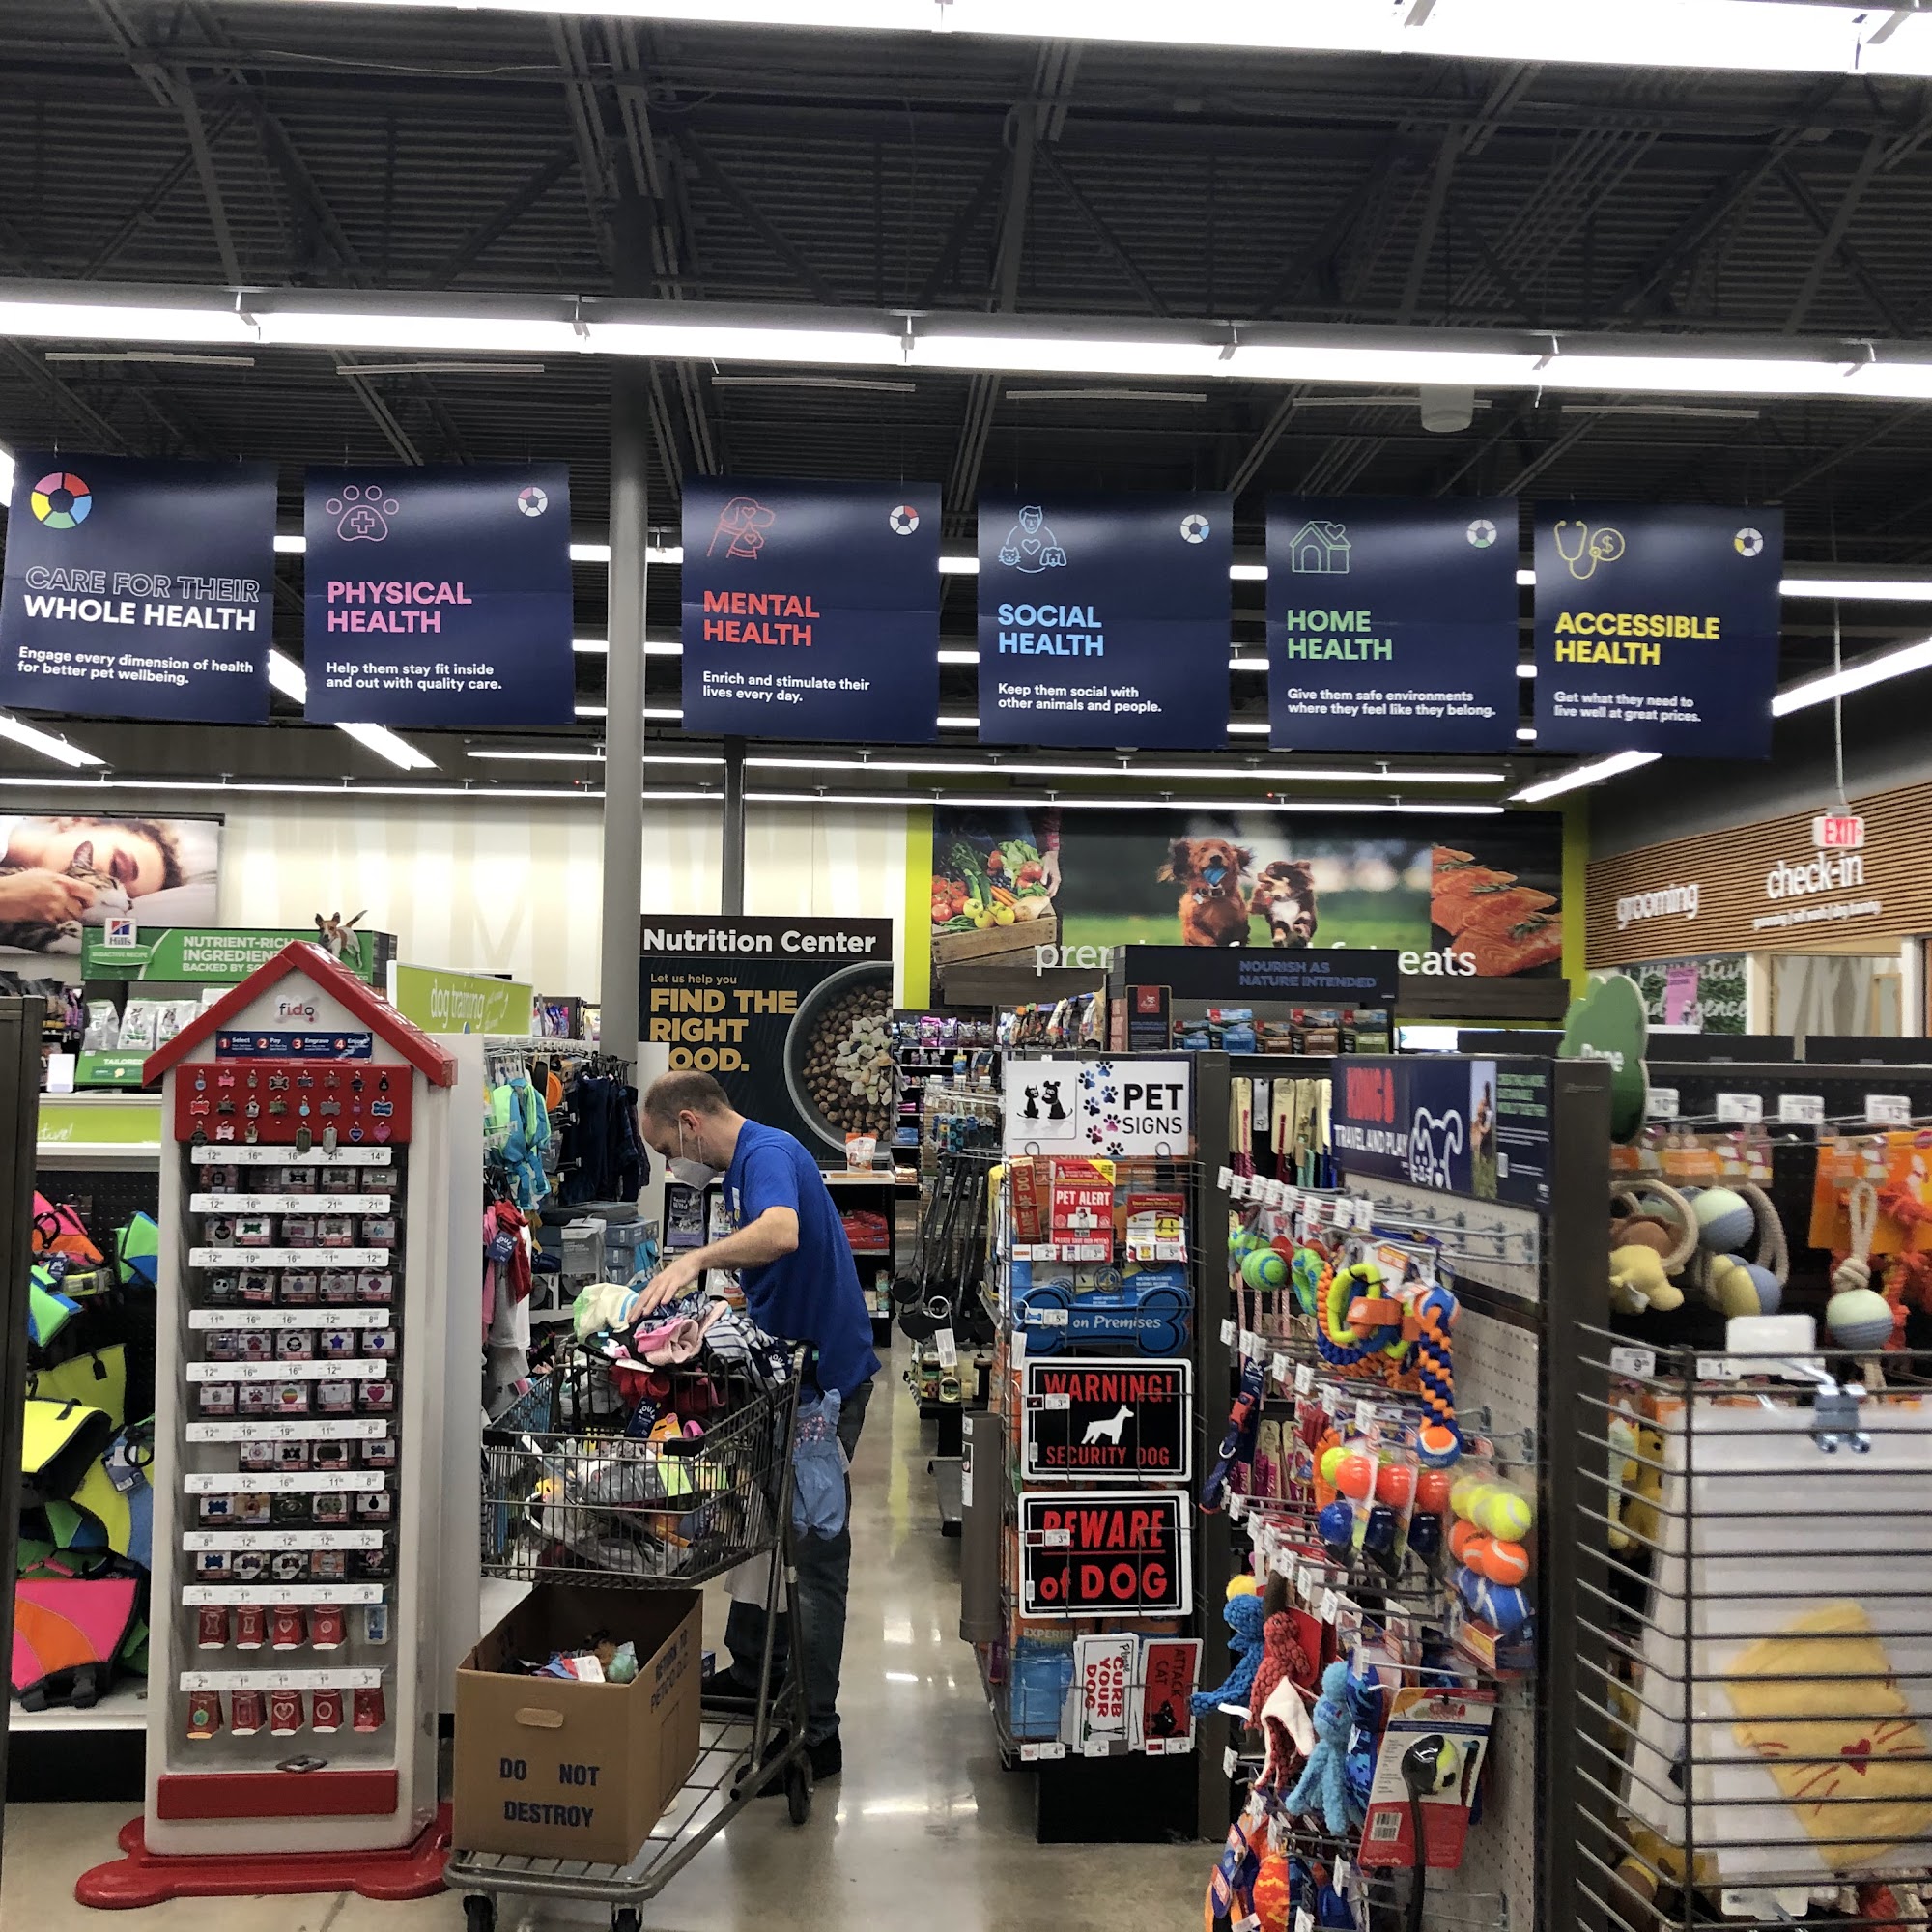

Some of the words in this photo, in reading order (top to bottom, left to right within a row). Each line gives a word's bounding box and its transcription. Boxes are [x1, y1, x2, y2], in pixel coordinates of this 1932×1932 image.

[26, 566, 106, 593] CARE
[113, 572, 171, 598] FOR
[177, 576, 259, 602] THEIR
[328, 582, 471, 604] PHYSICAL
[24, 594, 138, 624] WHOLE
[144, 601, 258, 631] HEALTH
[703, 591, 819, 618] MENTAL
[998, 604, 1101, 627] SOCIAL
[328, 611, 440, 633] HEALTH
[705, 620, 811, 646] HEALTH
[1288, 610, 1371, 632] HOME
[1555, 611, 1719, 639] ACCESSIBLE
[999, 633, 1103, 656] HEALTH
[1289, 638, 1392, 660] HEALTH
[1556, 640, 1660, 665] HEALTH
[18, 646, 71, 666] Engage
[74, 654, 115, 669] every
[118, 654, 189, 672] dimension
[193, 659, 208, 670] of
[212, 660, 253, 672] health
[18, 660, 39, 672] for
[38, 662, 88, 676] better
[91, 668, 114, 679] pet
[118, 666, 189, 686] wellbeing.
[327, 662, 358, 679] Help
[362, 663, 398, 673] them
[400, 665, 431, 681] stay
[435, 664, 449, 674] fit
[454, 664, 494, 674] inside
[327, 676, 351, 687] and
[356, 678, 379, 688] out
[384, 677, 412, 688] with
[417, 675, 465, 692] quality
[703, 671, 744, 688] Enrich
[749, 675, 772, 686] and
[777, 676, 836, 692] stimulate
[839, 678, 869, 690] their
[703, 685, 732, 697] lives
[736, 691, 773, 702] every
[777, 690, 803, 703] day.
[999, 683, 1031, 700] Keep
[1035, 684, 1066, 699] them
[1070, 686, 1107, 700] social
[1111, 687, 1138, 697] with
[1288, 689, 1317, 703] Give
[1320, 689, 1352, 699] them
[1356, 690, 1382, 700] safe
[1384, 690, 1473, 704] environments
[1554, 692, 1578, 702] Get
[1581, 693, 1613, 707] what
[1615, 694, 1644, 709] they
[1647, 696, 1677, 706] need
[1680, 697, 1693, 707] to
[999, 696, 1033, 708] other
[1036, 698, 1084, 710] animals
[1088, 700, 1110, 711] and
[1115, 701, 1161, 714] people.
[1288, 702, 1321, 713] where
[1330, 703, 1360, 718] they
[1362, 703, 1386, 714] feel
[1390, 703, 1412, 715] like
[1415, 704, 1444, 717] they
[1447, 704, 1495, 718] belong.
[1555, 705, 1577, 716] live
[1579, 706, 1606, 717] well
[1609, 708, 1622, 718] at
[1625, 706, 1658, 721] great
[1660, 710, 1701, 722] prices.
[1824, 818, 1858, 844] EXIT
[1767, 851, 1865, 899] check-in
[1616, 883, 1699, 930] grooming
[184, 936, 294, 949] NUTRIENT-RICH
[643, 929, 773, 953] Nutrition
[781, 931, 876, 954] Center
[183, 963, 226, 972] BACKED
[230, 963, 243, 972] BY
[1239, 961, 1306, 974] NOURISH
[1310, 962, 1331, 974] AS
[650, 973, 667, 984] Let
[671, 975, 684, 984] us
[689, 974, 719, 987] help
[715, 976, 737, 987] you
[1239, 976, 1298, 987] NATURE
[1302, 977, 1377, 988] INTENDED
[431, 979, 449, 1028] dog
[451, 983, 485, 1030] training
[649, 989, 728, 1012] FIND
[734, 990, 798, 1014] THE
[649, 1018, 749, 1042] RIGHT
[668, 1048, 749, 1072] OOD.
[1123, 1084, 1183, 1110] PET
[1122, 1117, 1182, 1134] SIGNS
[1016, 1168, 1031, 1192] DOG
[1056, 1190, 1076, 1205] PET
[1079, 1191, 1111, 1206] ALERT
[1073, 1319, 1089, 1328] on
[1094, 1315, 1161, 1329] Premises
[1043, 1374, 1172, 1403] WARNING!
[1046, 1446, 1126, 1466] SECURITY
[1136, 1448, 1170, 1466] DOG
[1040, 1567, 1070, 1600] of
[1081, 1564, 1167, 1600] DOG
[1155, 1661, 1169, 1685] CAT
[1171, 1649, 1186, 1697] ATTACK
[1085, 1664, 1097, 1710] DOG
[1097, 1657, 1111, 1718] YOUR
[1111, 1657, 1124, 1718] CURB
[499, 1757, 526, 1781] DO
[559, 1764, 600, 1786] NOT
[504, 1801, 594, 1827] DESTROY
